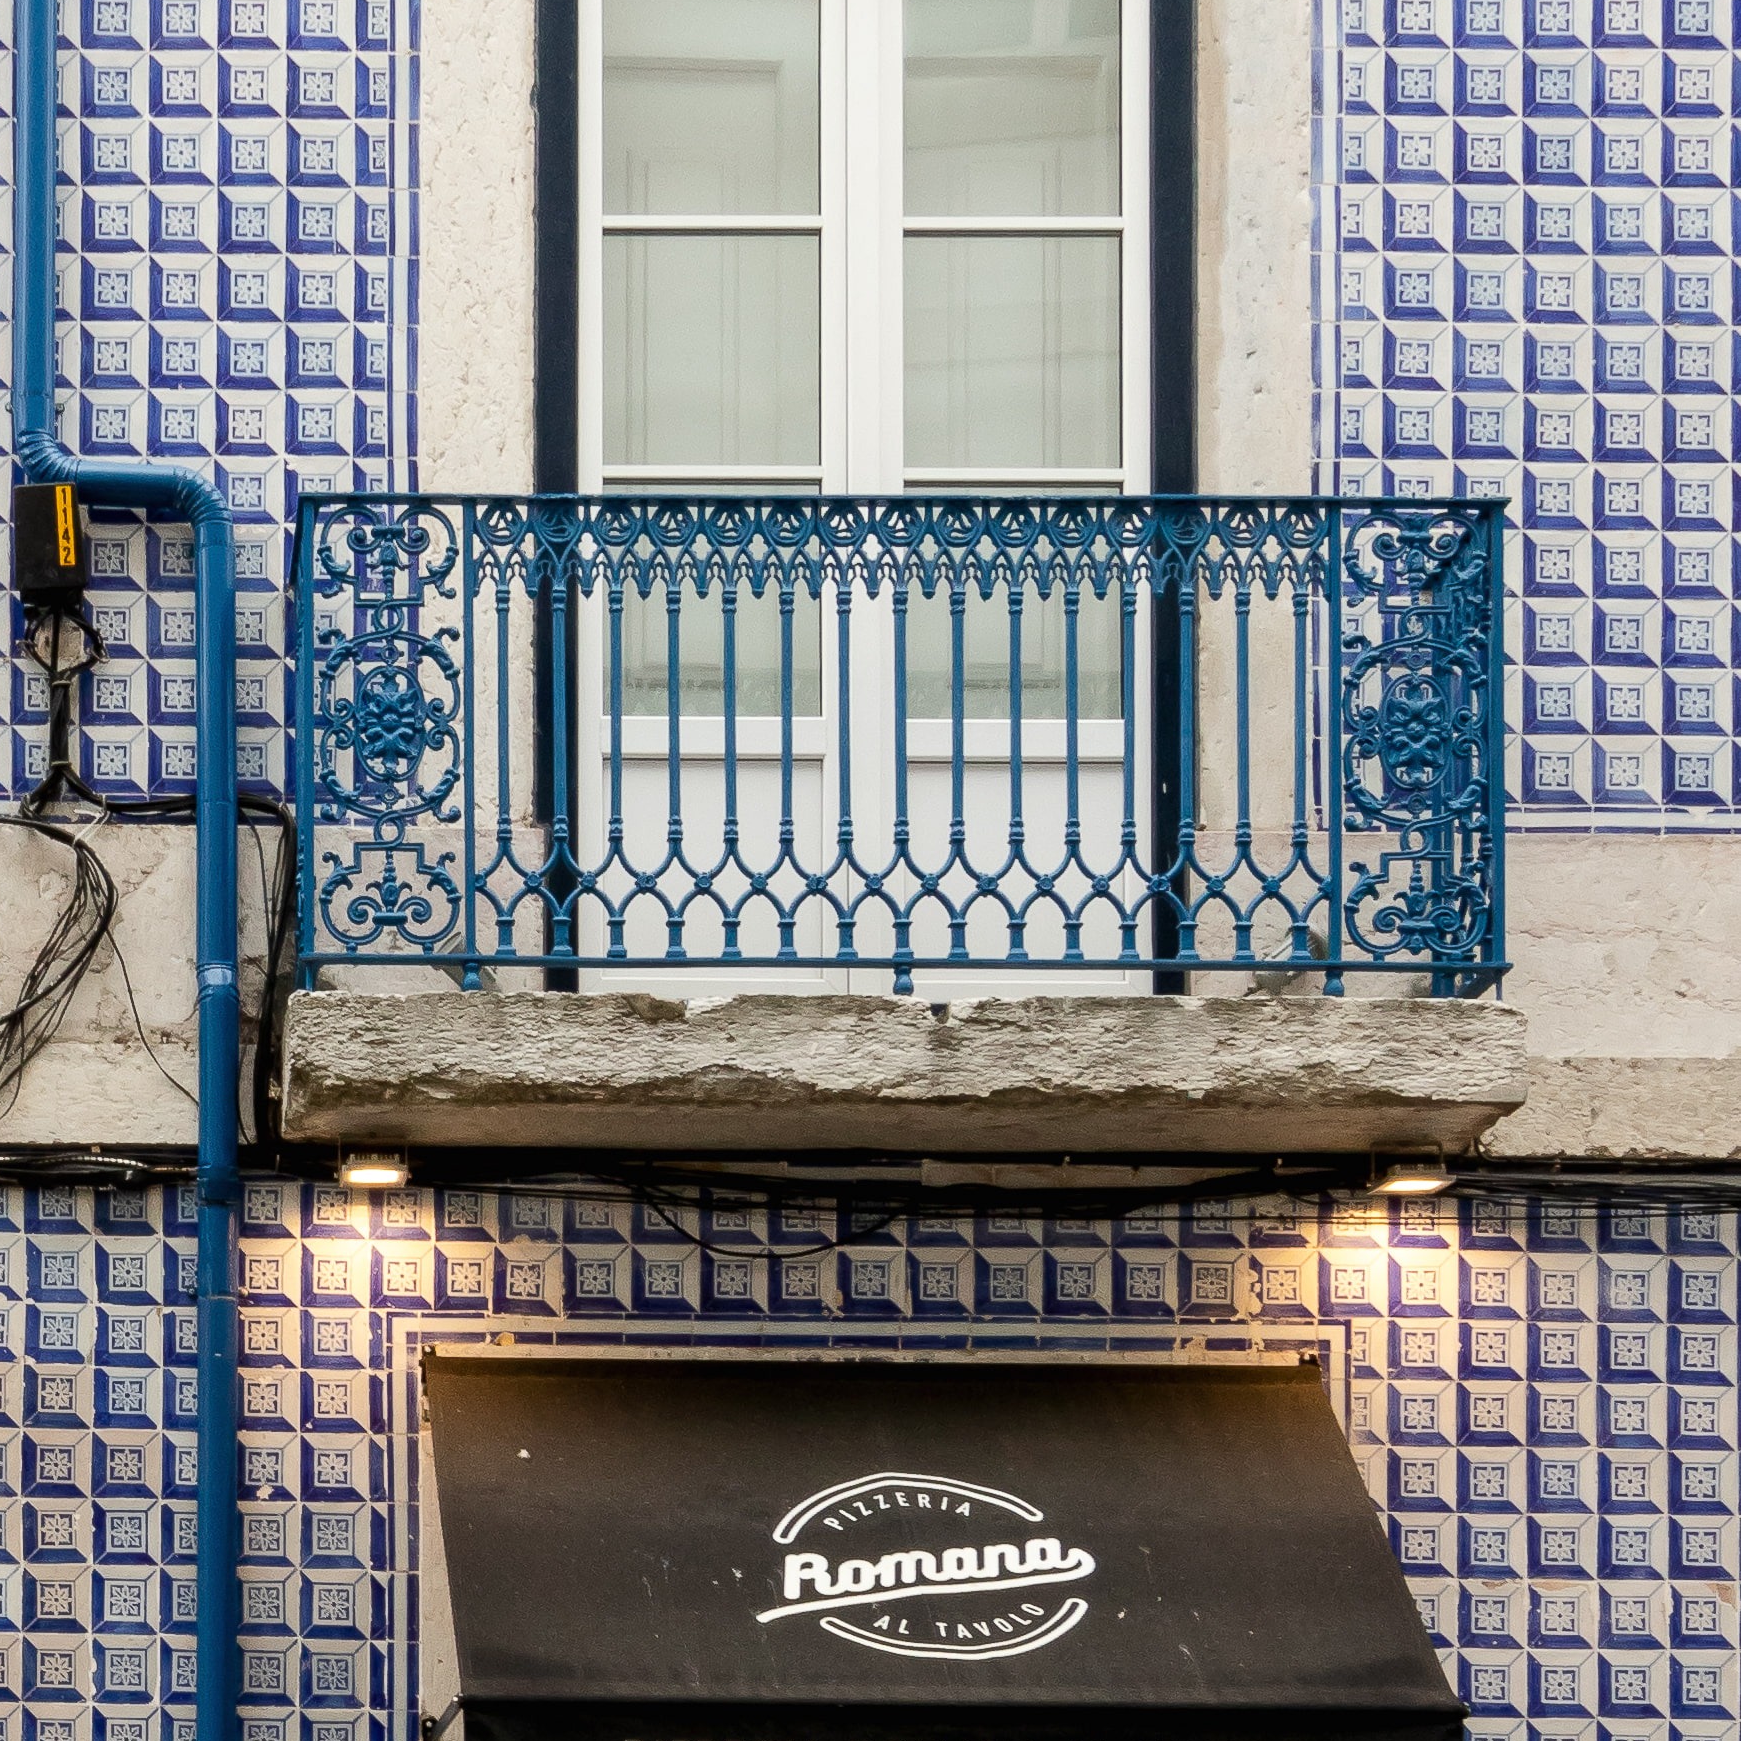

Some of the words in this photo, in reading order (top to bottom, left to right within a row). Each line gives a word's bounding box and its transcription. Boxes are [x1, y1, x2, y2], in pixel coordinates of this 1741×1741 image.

[61, 487, 72, 564] 1142
[822, 1491, 972, 1531] PIZZERIA
[783, 1537, 1089, 1601] Romana
[872, 1615, 910, 1635] AL
[935, 1603, 1045, 1640] TAVOLO
